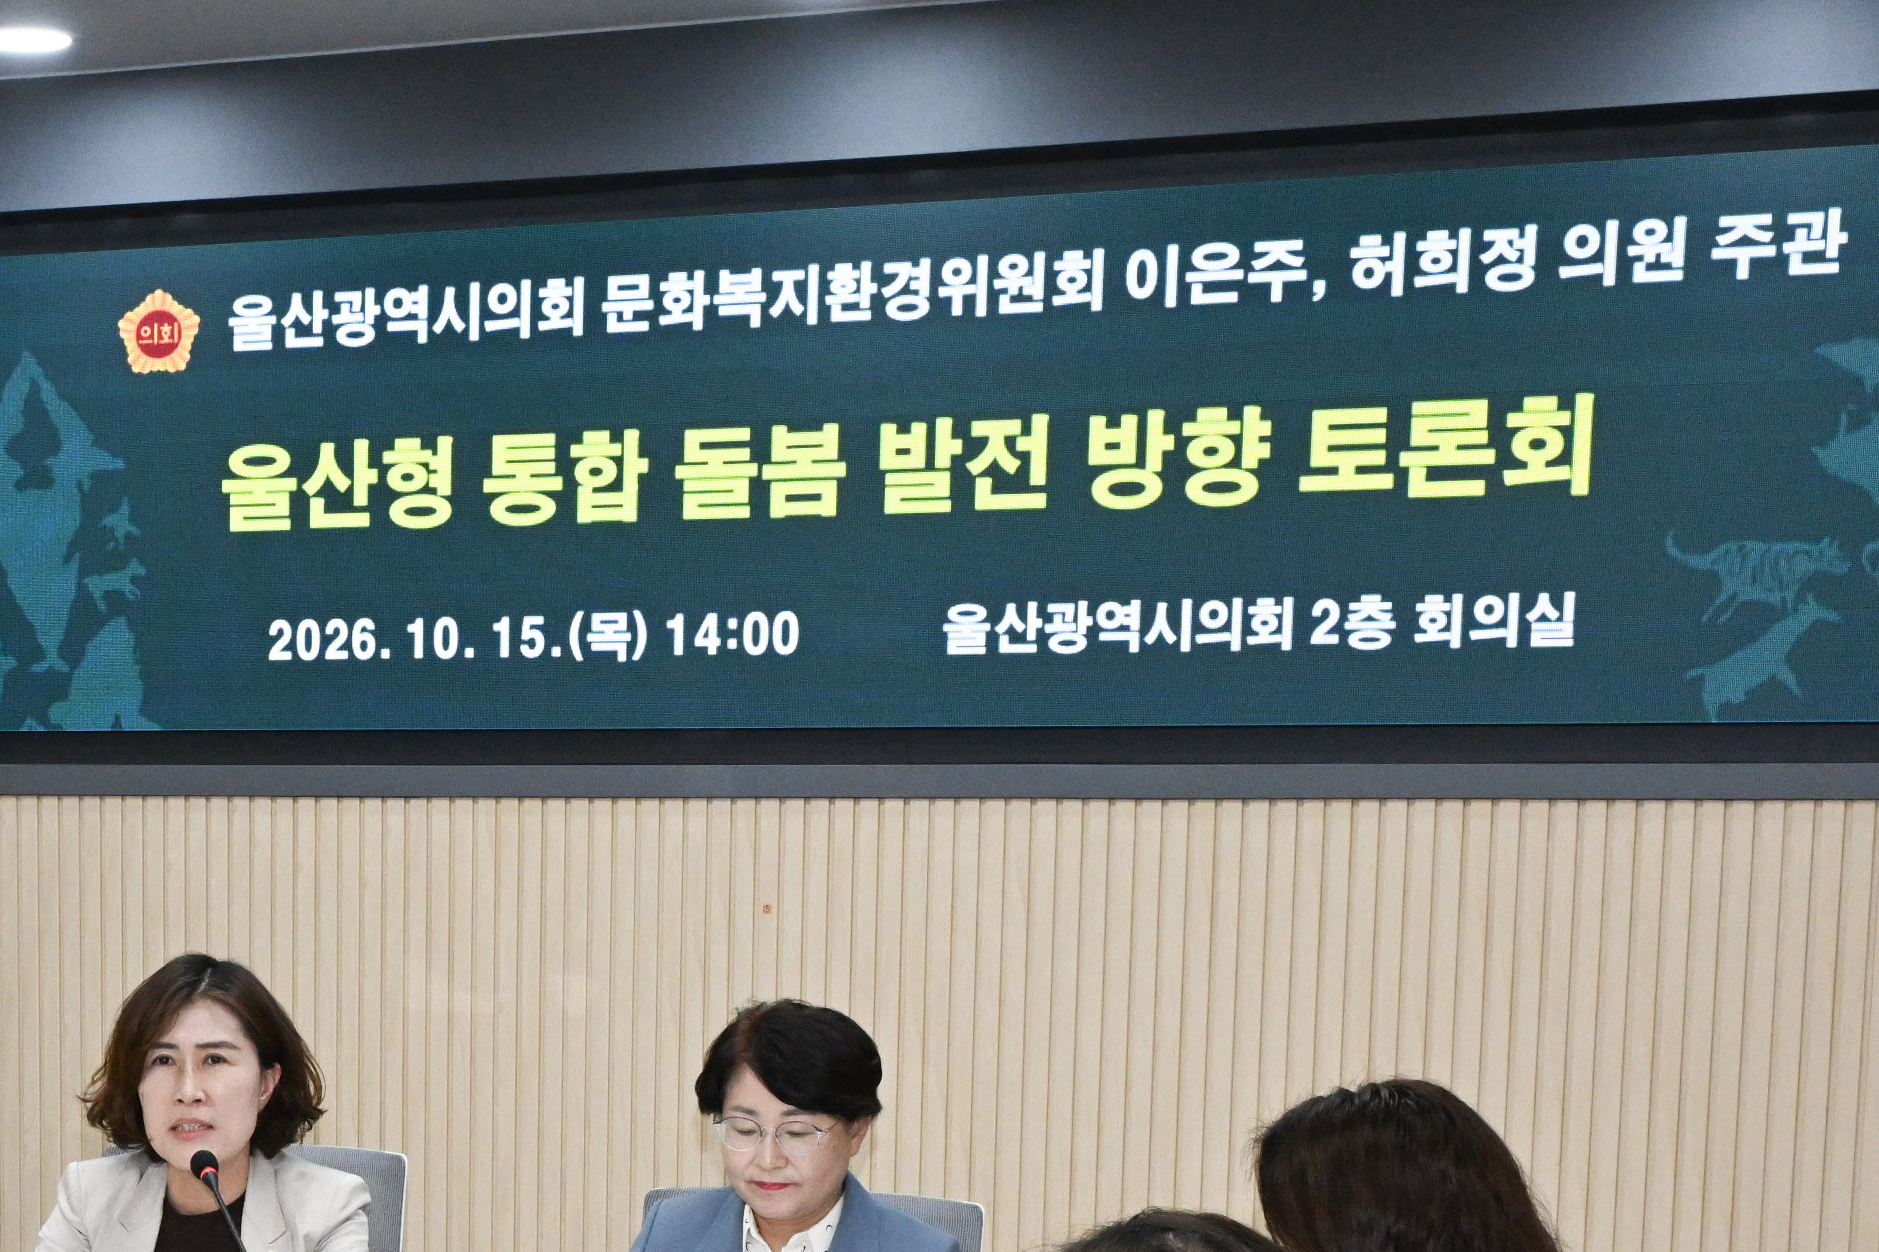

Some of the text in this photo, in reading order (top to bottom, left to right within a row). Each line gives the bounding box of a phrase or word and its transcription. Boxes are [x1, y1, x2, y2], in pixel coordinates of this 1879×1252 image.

[228, 207, 1848, 351] 울산광역시의회 문화복지환경위원회 이은주, 허희정 의원 주관
[138, 318, 180, 348] 의회
[222, 393, 1594, 532] 울산형 통합 돌봄 발전 방향 토론회
[269, 610, 799, 662] 2026. 10. 15.(목) 14:00
[943, 591, 1575, 655] 울산광역시의회 2층 회의실
